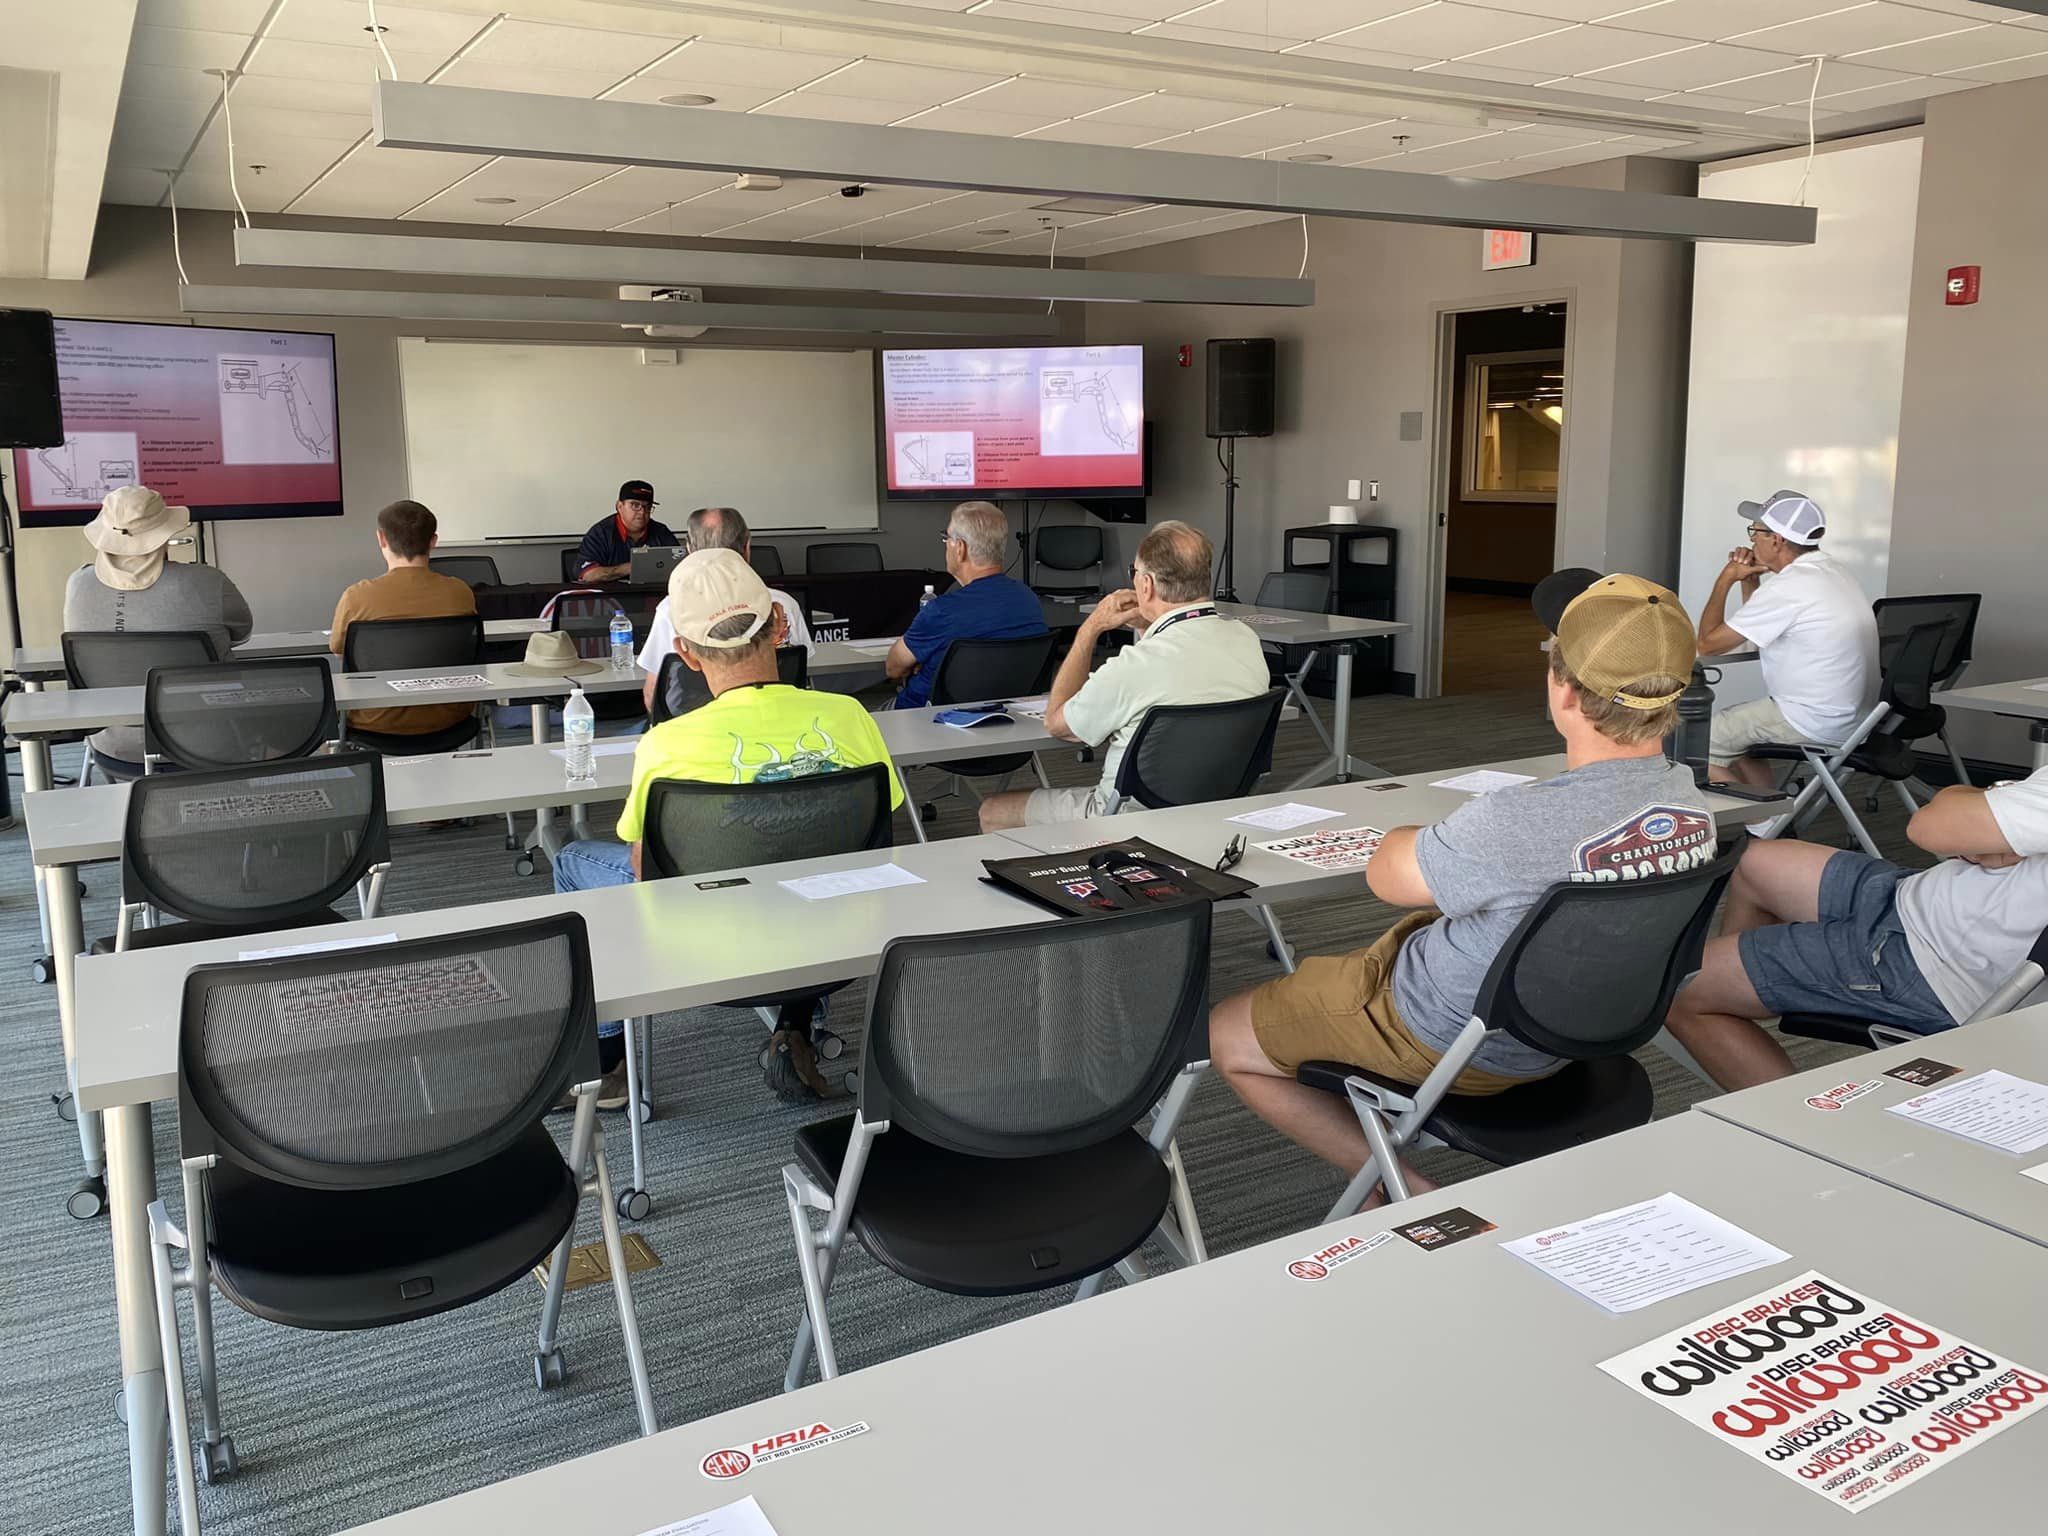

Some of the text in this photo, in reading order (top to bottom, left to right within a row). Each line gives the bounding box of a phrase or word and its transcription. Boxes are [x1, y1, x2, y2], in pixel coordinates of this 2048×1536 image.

[1611, 830, 1705, 862] CHAMPIONSHIP
[1823, 1083, 1860, 1100] HRIA
[1313, 1237, 1365, 1263] HRIA
[1694, 1283, 1824, 1344] DISC BRAKES
[1641, 1279, 1866, 1397] wilwood
[1763, 1317, 1893, 1381] DISC BRAKES
[1712, 1313, 1941, 1438] wilwood
[1859, 1345, 1997, 1425] wilwood
[1887, 1347, 1968, 1391] DISC BRAKES
[1911, 1368, 2048, 1453] wilwood
[1939, 1371, 2019, 1417] DISC BRAKES
[752, 1423, 831, 1455] HRIA
[757, 1425, 866, 1464] HOT ROD INDUSTRY ALLIANCE
[705, 1451, 749, 1477] SEMA
